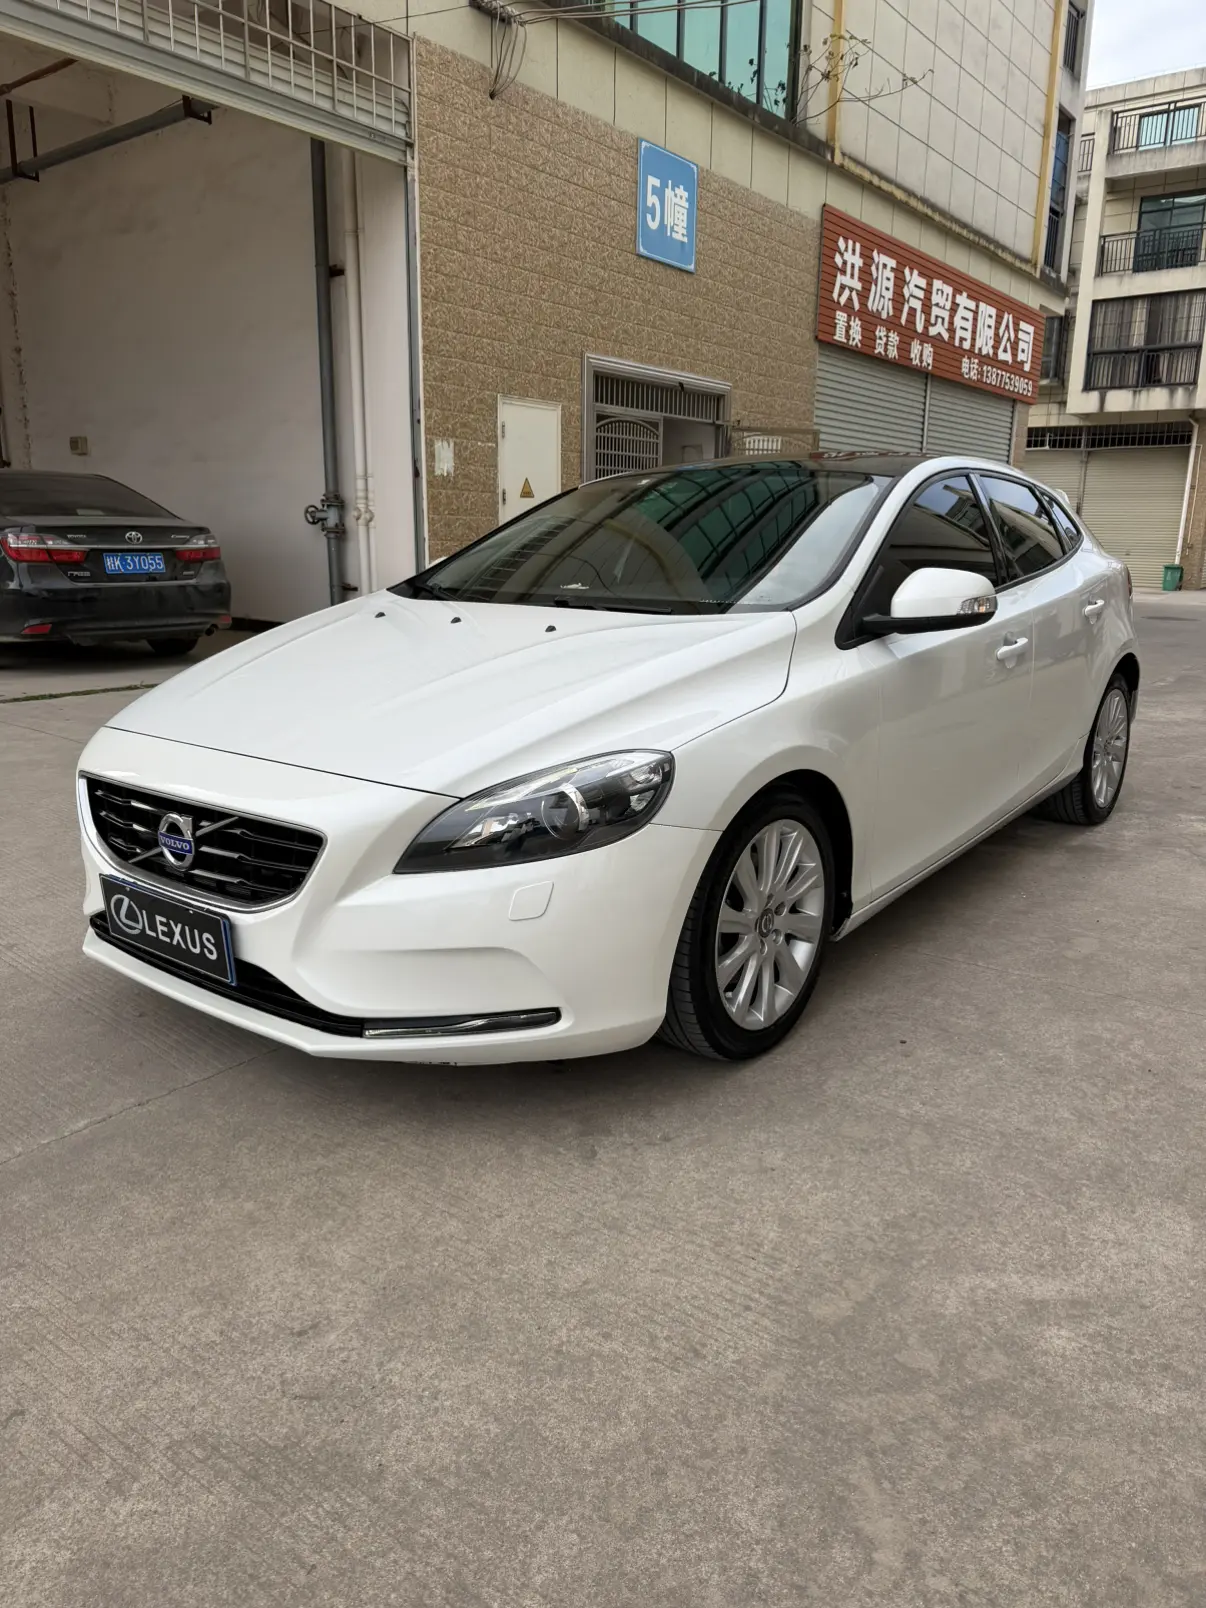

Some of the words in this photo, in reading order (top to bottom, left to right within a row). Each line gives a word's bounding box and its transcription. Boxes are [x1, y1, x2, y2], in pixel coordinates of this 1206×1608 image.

[646, 174, 689, 243] 5幢
[832, 236, 1035, 372] 洪源汽贸有限公司
[833, 310, 862, 348] 置换
[874, 325, 899, 360] 贷款
[910, 338, 934, 370] 收购
[160, 836, 190, 850] VOLVO
[142, 909, 218, 960] LEXUS
